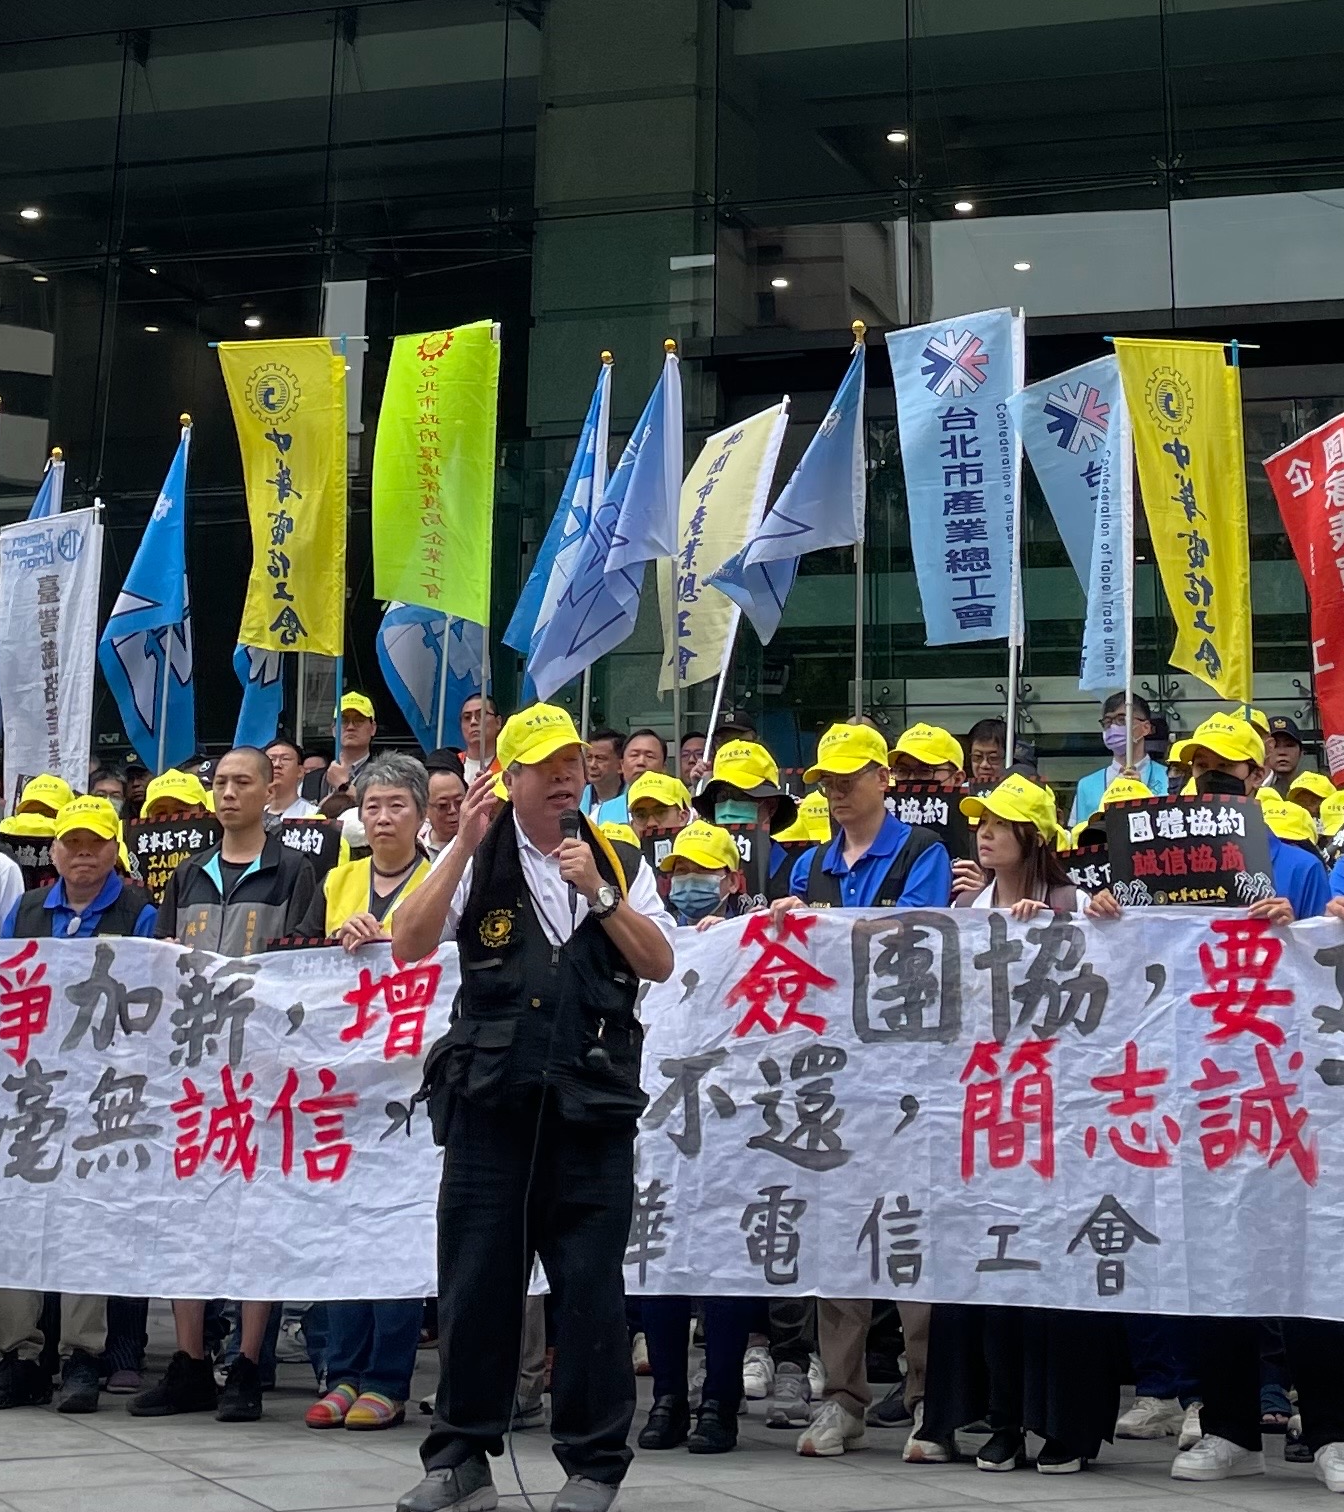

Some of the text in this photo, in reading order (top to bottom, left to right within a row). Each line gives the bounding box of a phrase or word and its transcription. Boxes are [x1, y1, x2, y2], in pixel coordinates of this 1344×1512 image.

[937, 405, 997, 630] 台北市產業總工會
[1100, 449, 1117, 678] Confederation of Taipei Trade Unions
[137, 828, 215, 855] 董事長下台！
[282, 827, 325, 856] 協約
[1127, 805, 1246, 844] 團體協約
[1131, 840, 1247, 878] 誠信協商
[622, 1178, 1161, 1297] 華電信工會
